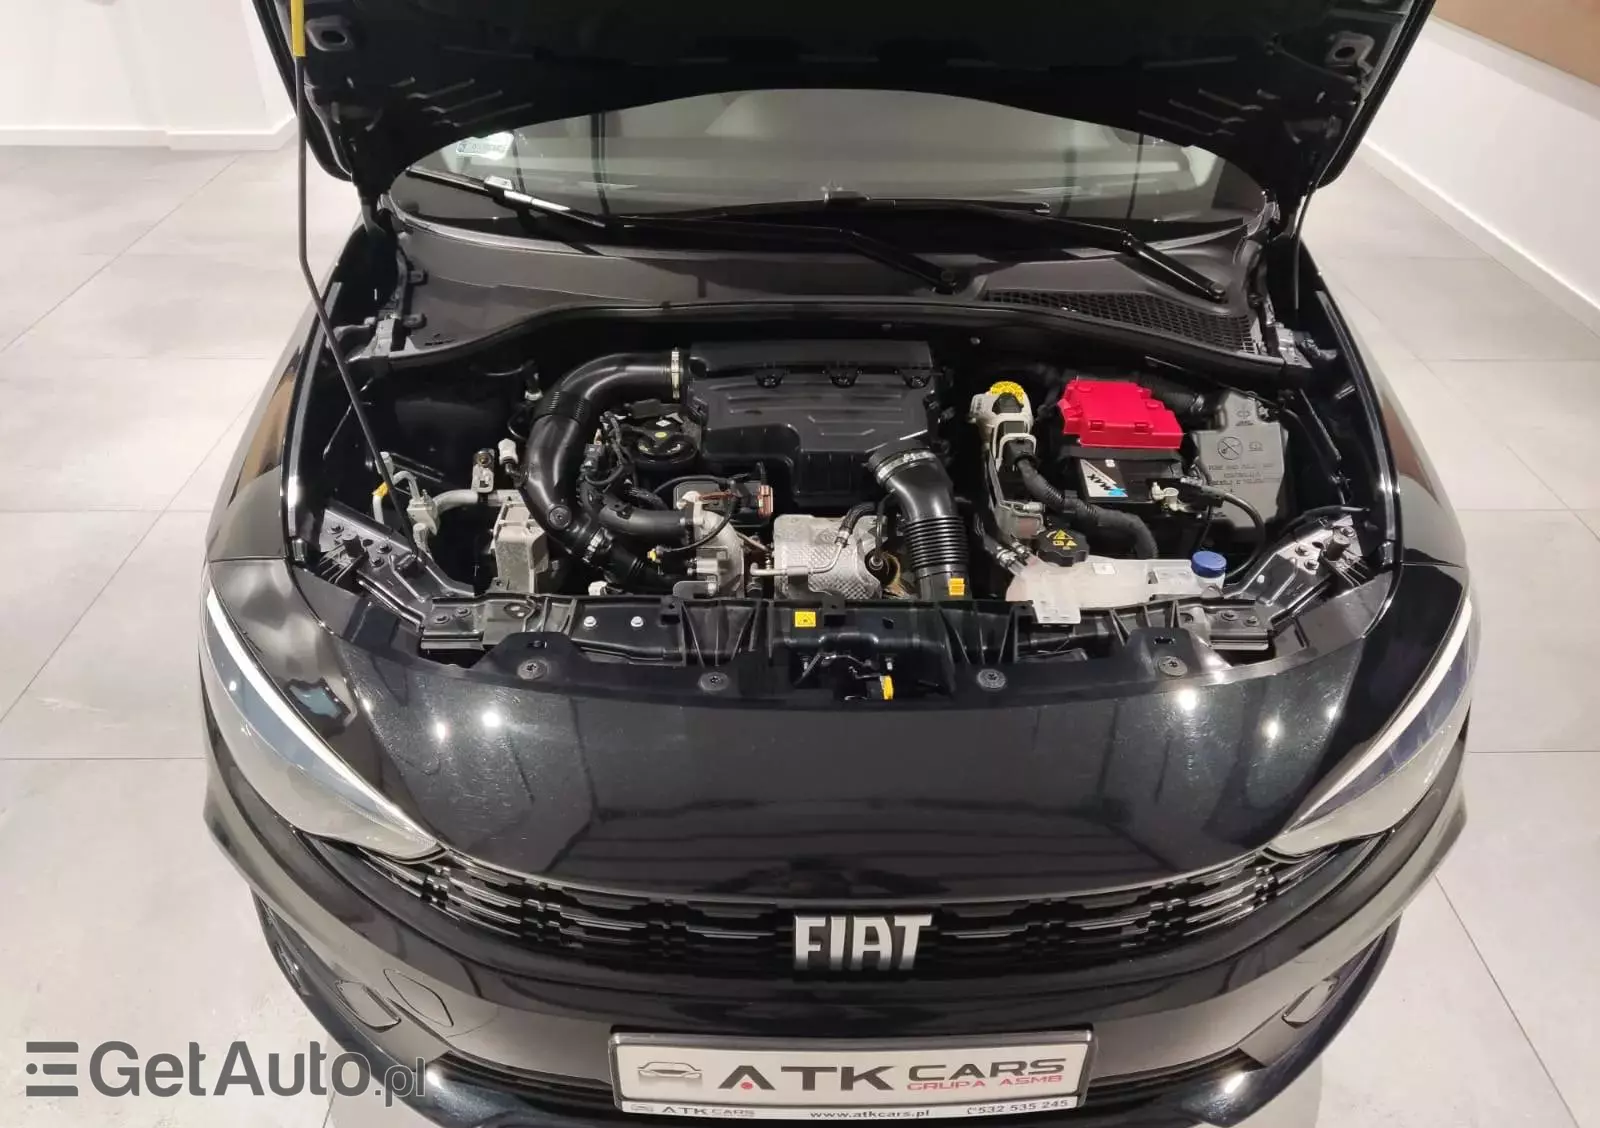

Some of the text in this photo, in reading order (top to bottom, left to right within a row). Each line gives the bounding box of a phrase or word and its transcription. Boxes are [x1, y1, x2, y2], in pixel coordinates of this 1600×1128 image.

[794, 914, 932, 970] FIAT
[718, 1058, 1066, 1091] ATK CARS
[907, 1080, 986, 1091] GRUPA
[662, 1106, 755, 1117] ATK CARS
[978, 1099, 1068, 1114] 532 535 245
[810, 1110, 930, 1119] www.atkcars.pl
